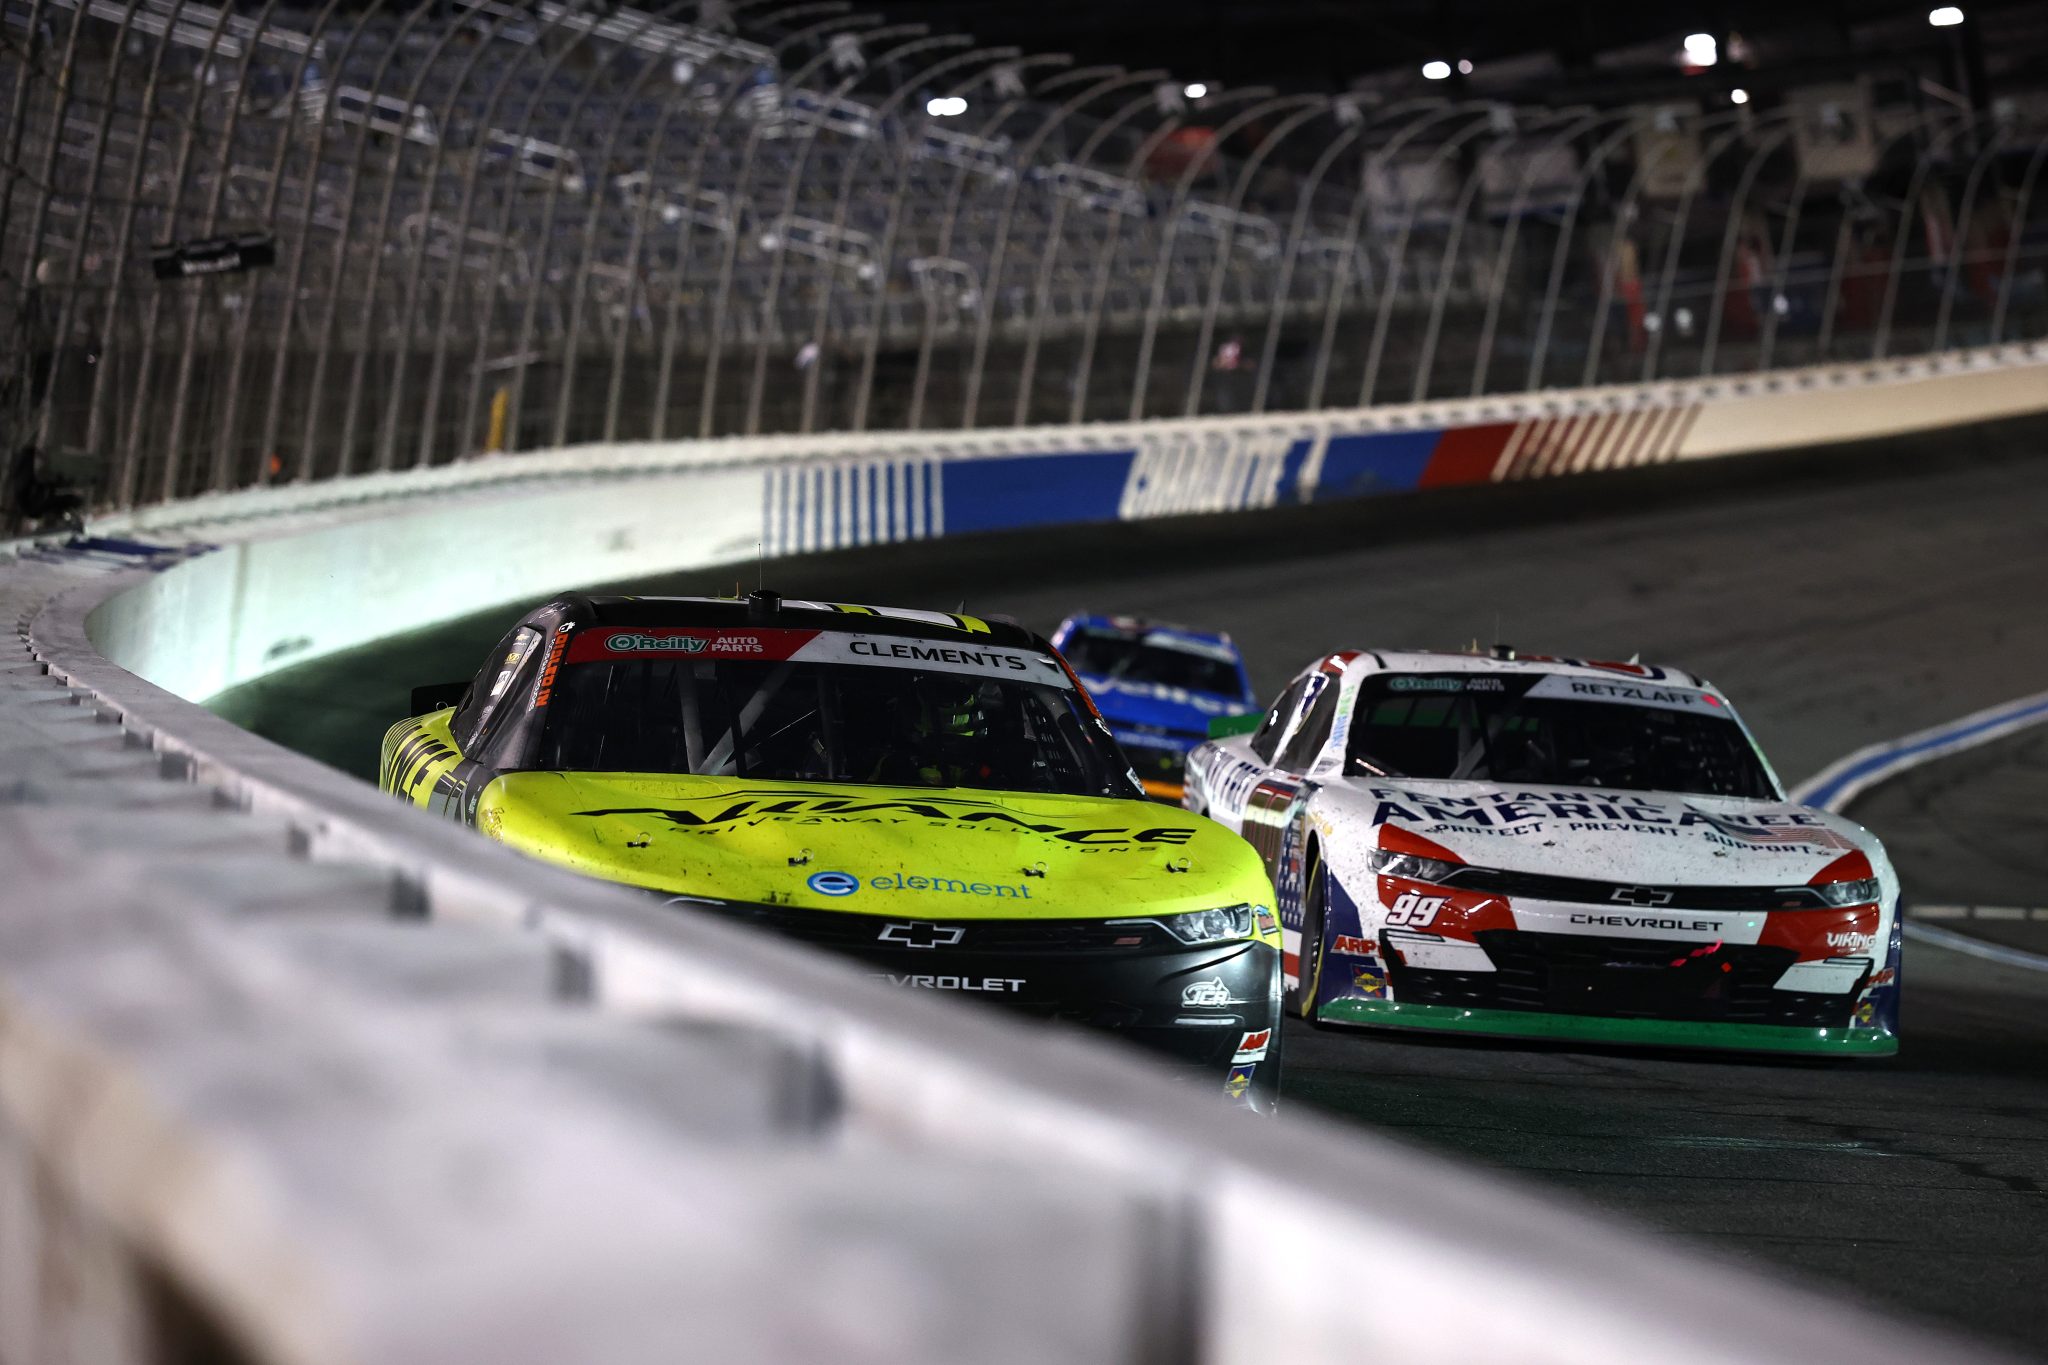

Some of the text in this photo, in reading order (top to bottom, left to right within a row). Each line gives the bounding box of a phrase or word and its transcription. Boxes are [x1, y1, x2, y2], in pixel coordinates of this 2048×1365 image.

[604, 634, 711, 653] O'Reilly
[711, 643, 763, 653] PARTS
[716, 636, 758, 645] AUTO
[850, 641, 1027, 671] CLEMENTS
[1571, 682, 1696, 705] RETZLAFF
[1369, 788, 1667, 809] FENTANYL
[1372, 801, 1729, 835] AMERICA
[1432, 821, 1811, 855] PROTECT PREVENT SUPPORT
[870, 872, 1033, 899] element
[1386, 893, 1452, 928] 99
[1570, 913, 1724, 932] CHEVROLET
[1334, 935, 1378, 955] ARP
[1827, 931, 1877, 947] VIKING
